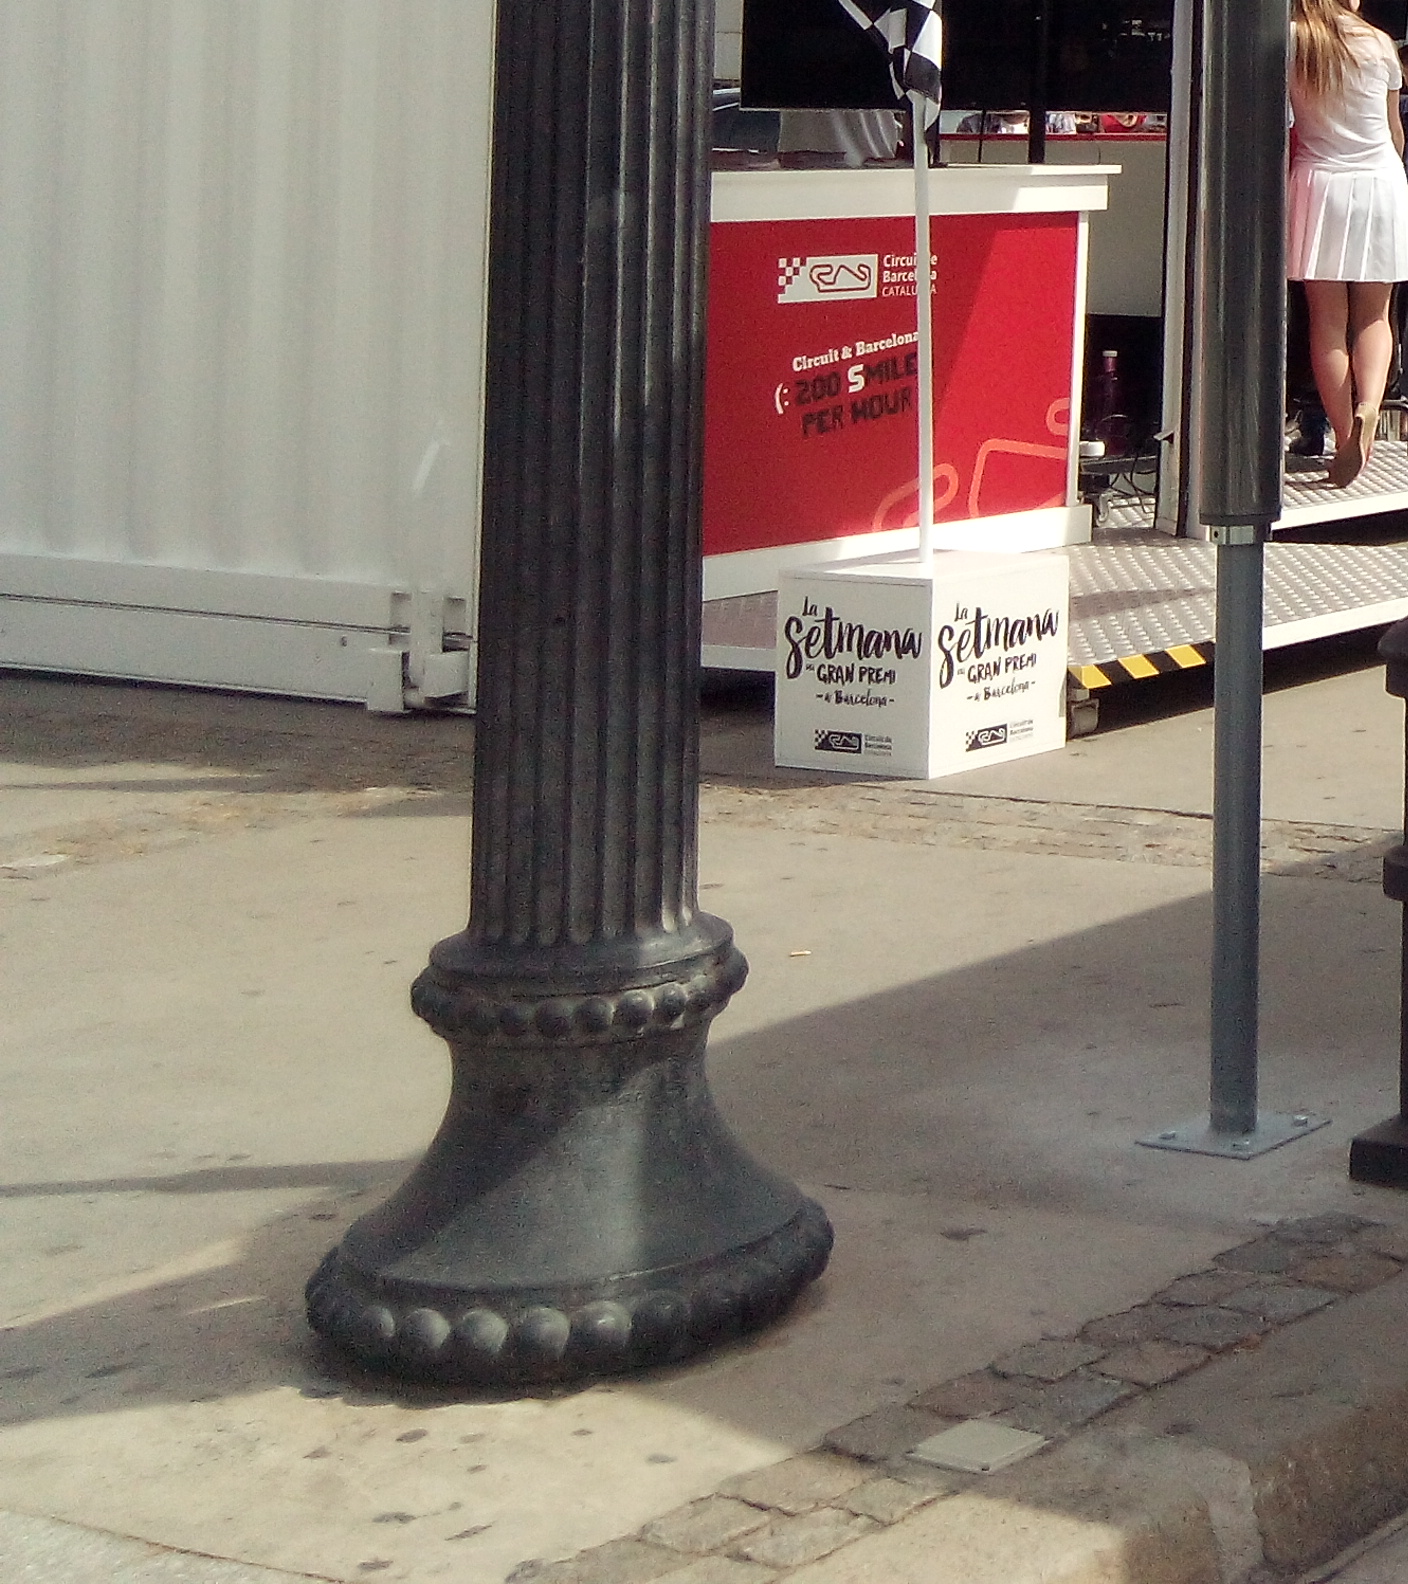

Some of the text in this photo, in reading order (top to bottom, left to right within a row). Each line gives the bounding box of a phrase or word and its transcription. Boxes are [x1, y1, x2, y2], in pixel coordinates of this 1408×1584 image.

[882, 252, 918, 268] Circui
[881, 282, 939, 298] CATALUA
[792, 348, 840, 372] Circuit
[841, 345, 853, 361] &
[795, 351, 919, 407] 200 SMILE
[801, 387, 913, 437] PER HOUR
[801, 595, 818, 616] La
[953, 602, 969, 623] La
[784, 606, 923, 680] Setmana
[937, 606, 1060, 690] Setmana
[816, 662, 897, 687] GRAN PREMI
[967, 652, 1038, 685] GRAN PREMI
